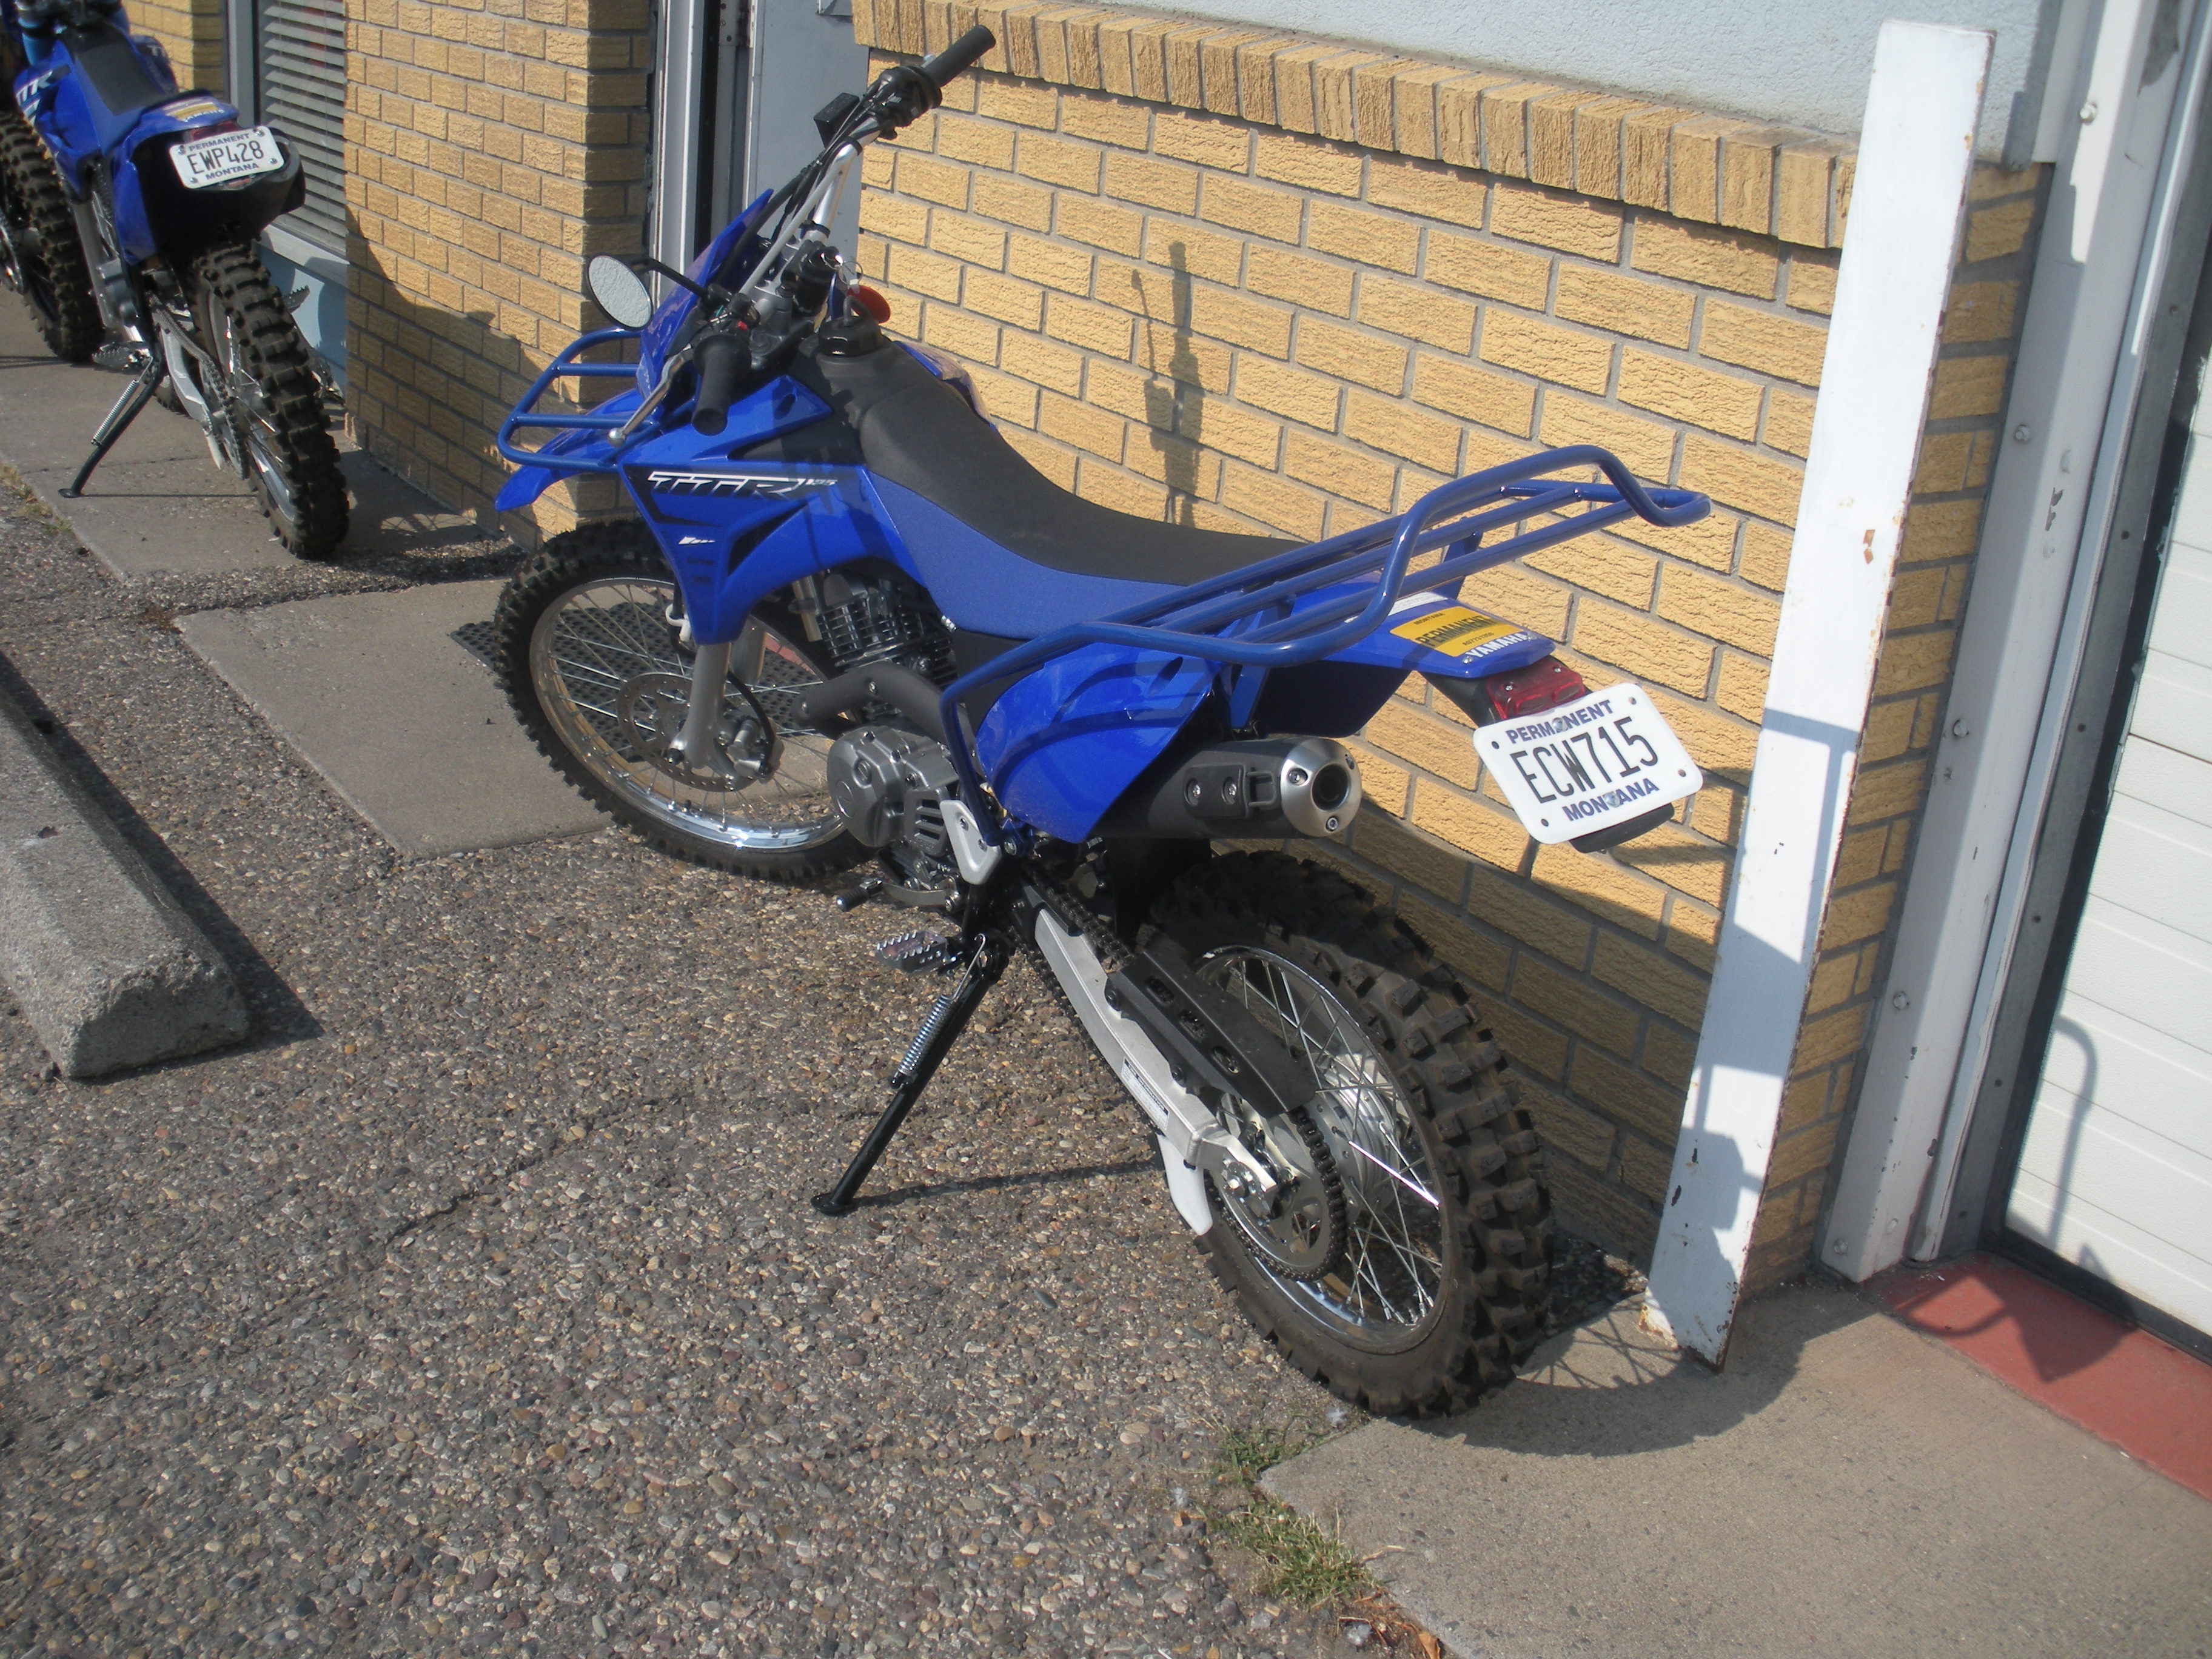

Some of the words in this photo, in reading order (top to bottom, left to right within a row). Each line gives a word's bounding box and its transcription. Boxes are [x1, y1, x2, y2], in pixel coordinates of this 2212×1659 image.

[187, 140, 264, 175] EWP428
[189, 133, 250, 152] PERMANENT
[206, 162, 259, 180] MONTANA
[1413, 612, 1446, 625] MONTANA
[1415, 615, 1498, 647] PERMANENT
[1466, 632, 1528, 658] YAMAHA
[1506, 699, 1615, 744] PERMNENT
[1509, 716, 1658, 804] ECW715
[1562, 778, 1660, 821] MONANA
